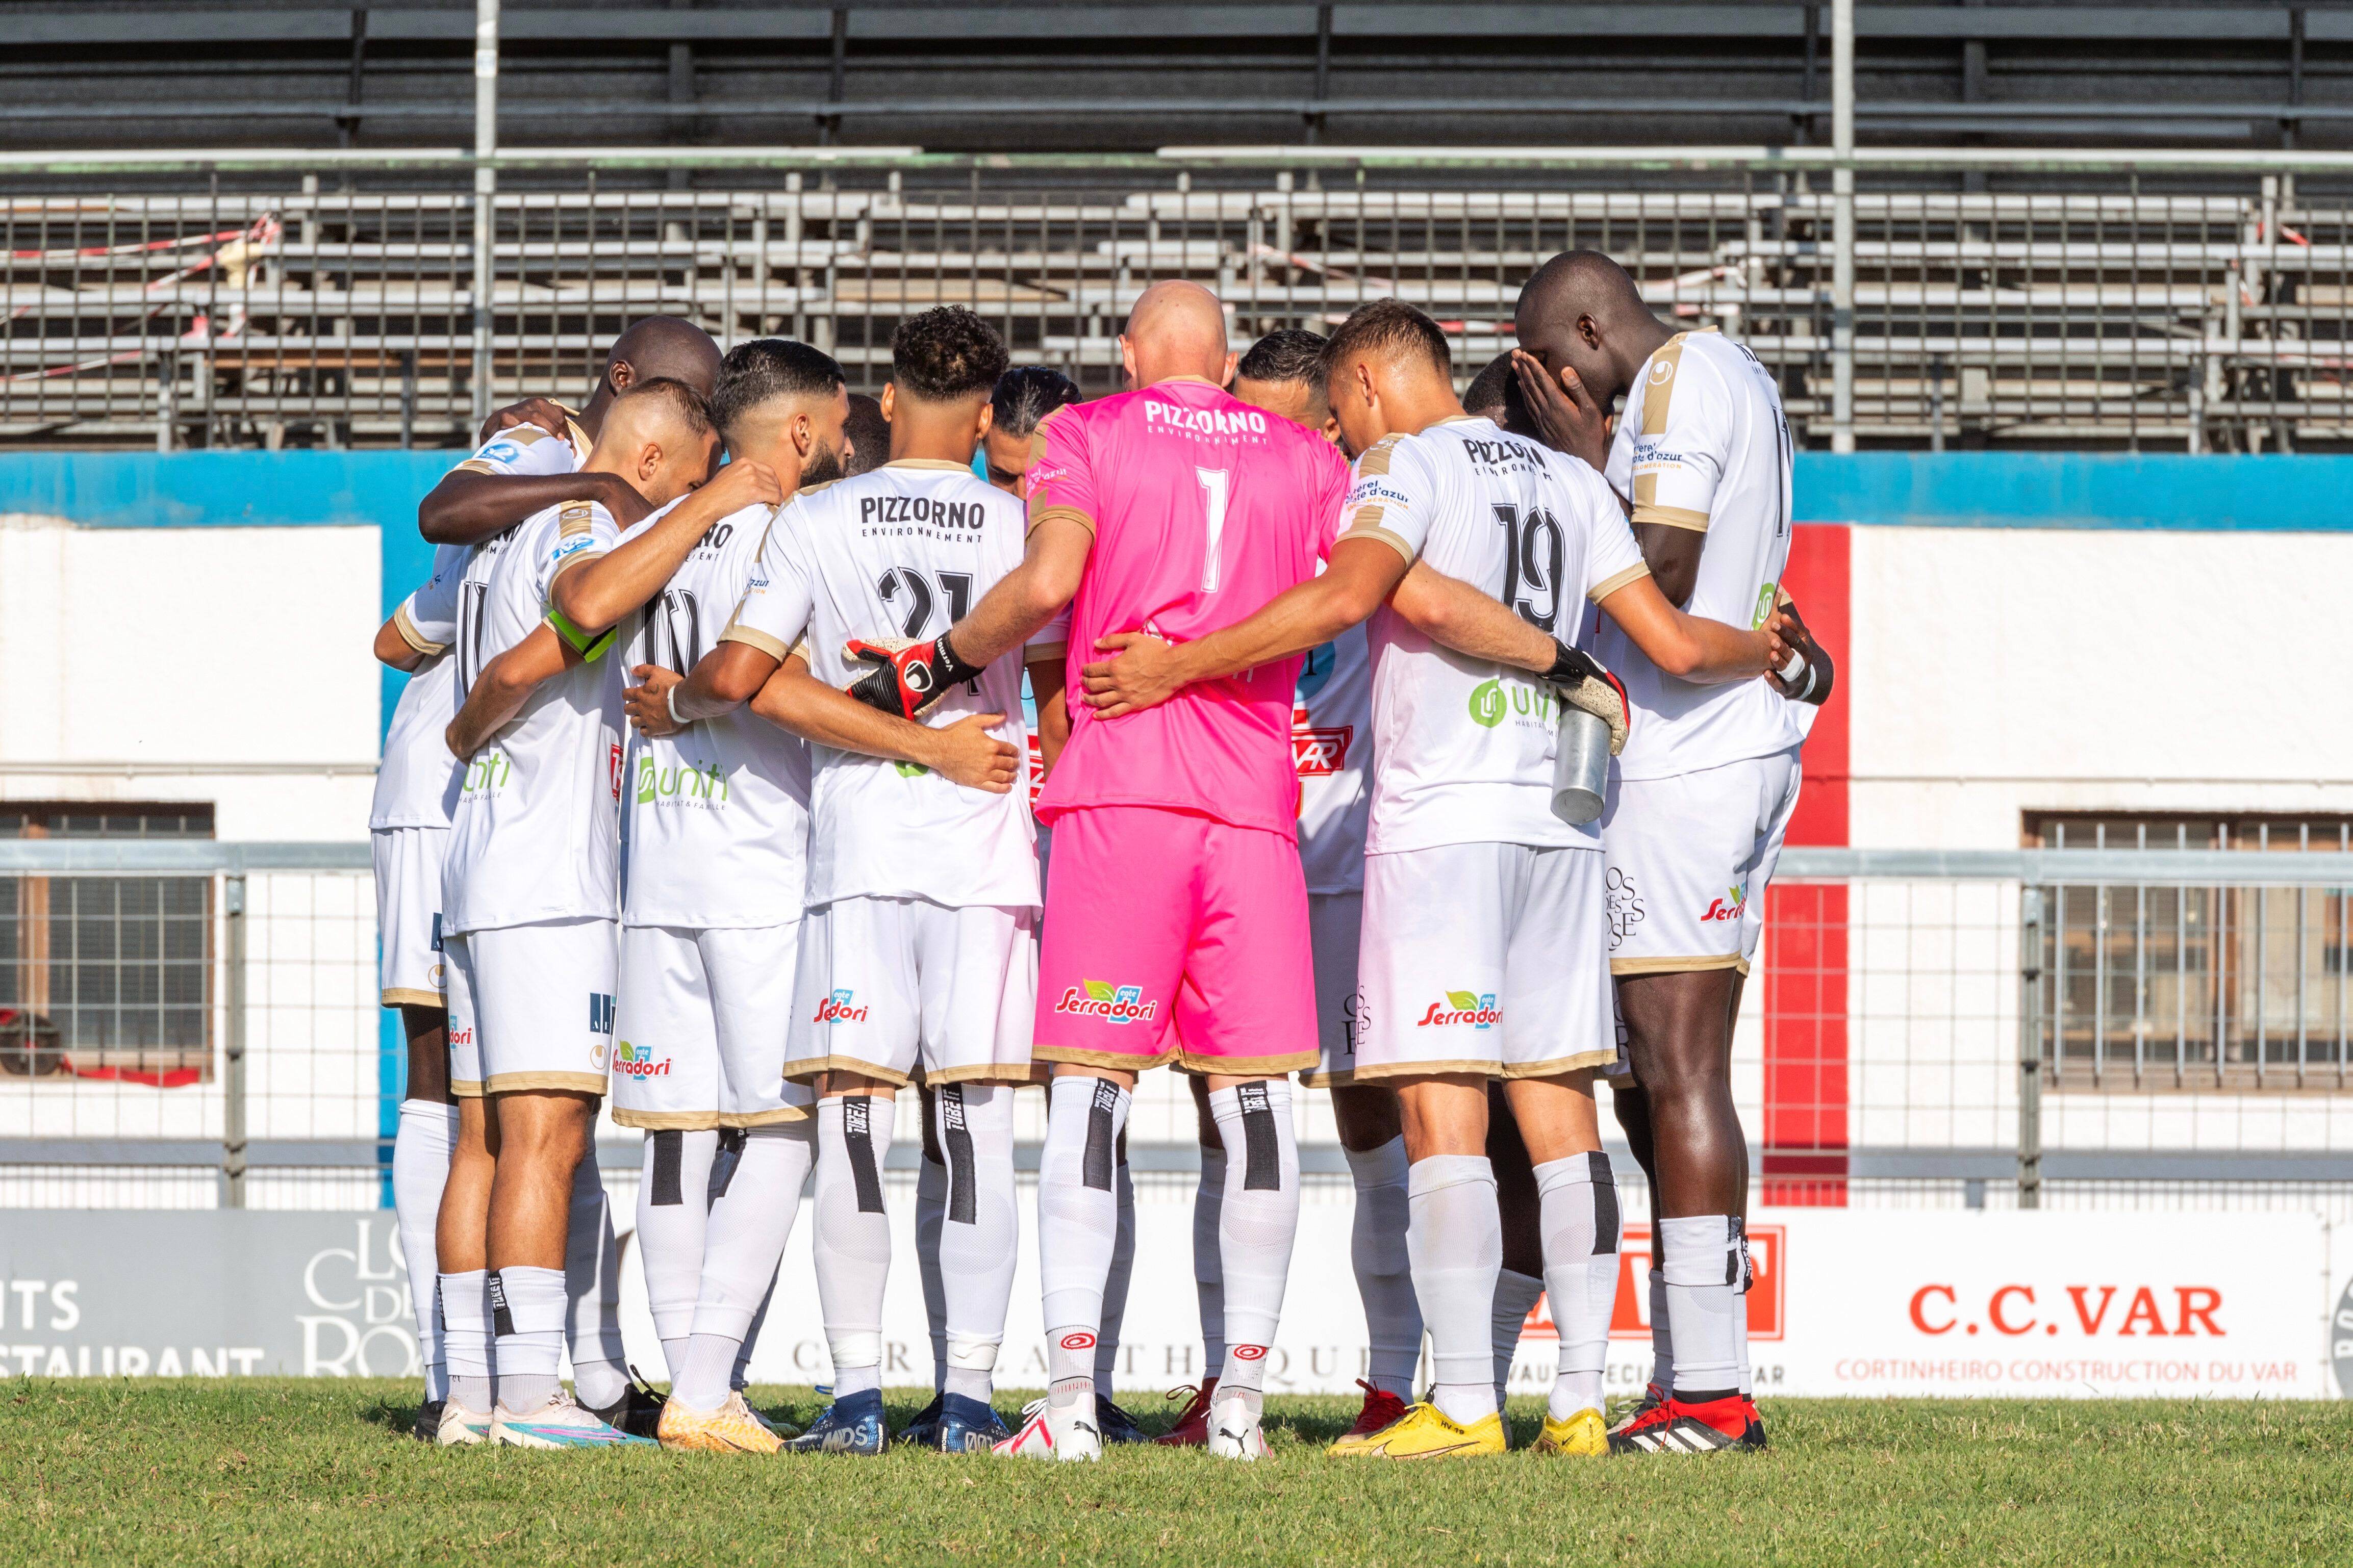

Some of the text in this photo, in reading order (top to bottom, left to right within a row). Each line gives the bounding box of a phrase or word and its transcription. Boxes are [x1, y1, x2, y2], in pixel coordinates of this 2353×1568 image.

[1145, 401, 1266, 434] PIZZORNO
[1370, 487, 1408, 502] d'azur
[861, 496, 984, 529] PIZZORNO
[1195, 465, 1229, 593] 1
[862, 527, 982, 543] ENVIRONNEMENT
[1491, 503, 1565, 635] 19
[878, 567, 974, 676] 21
[1056, 989, 1156, 1019] Serradori
[1835, 1358, 2297, 1382] CORTINHEIRO CONSTRUCTION DU VAR
